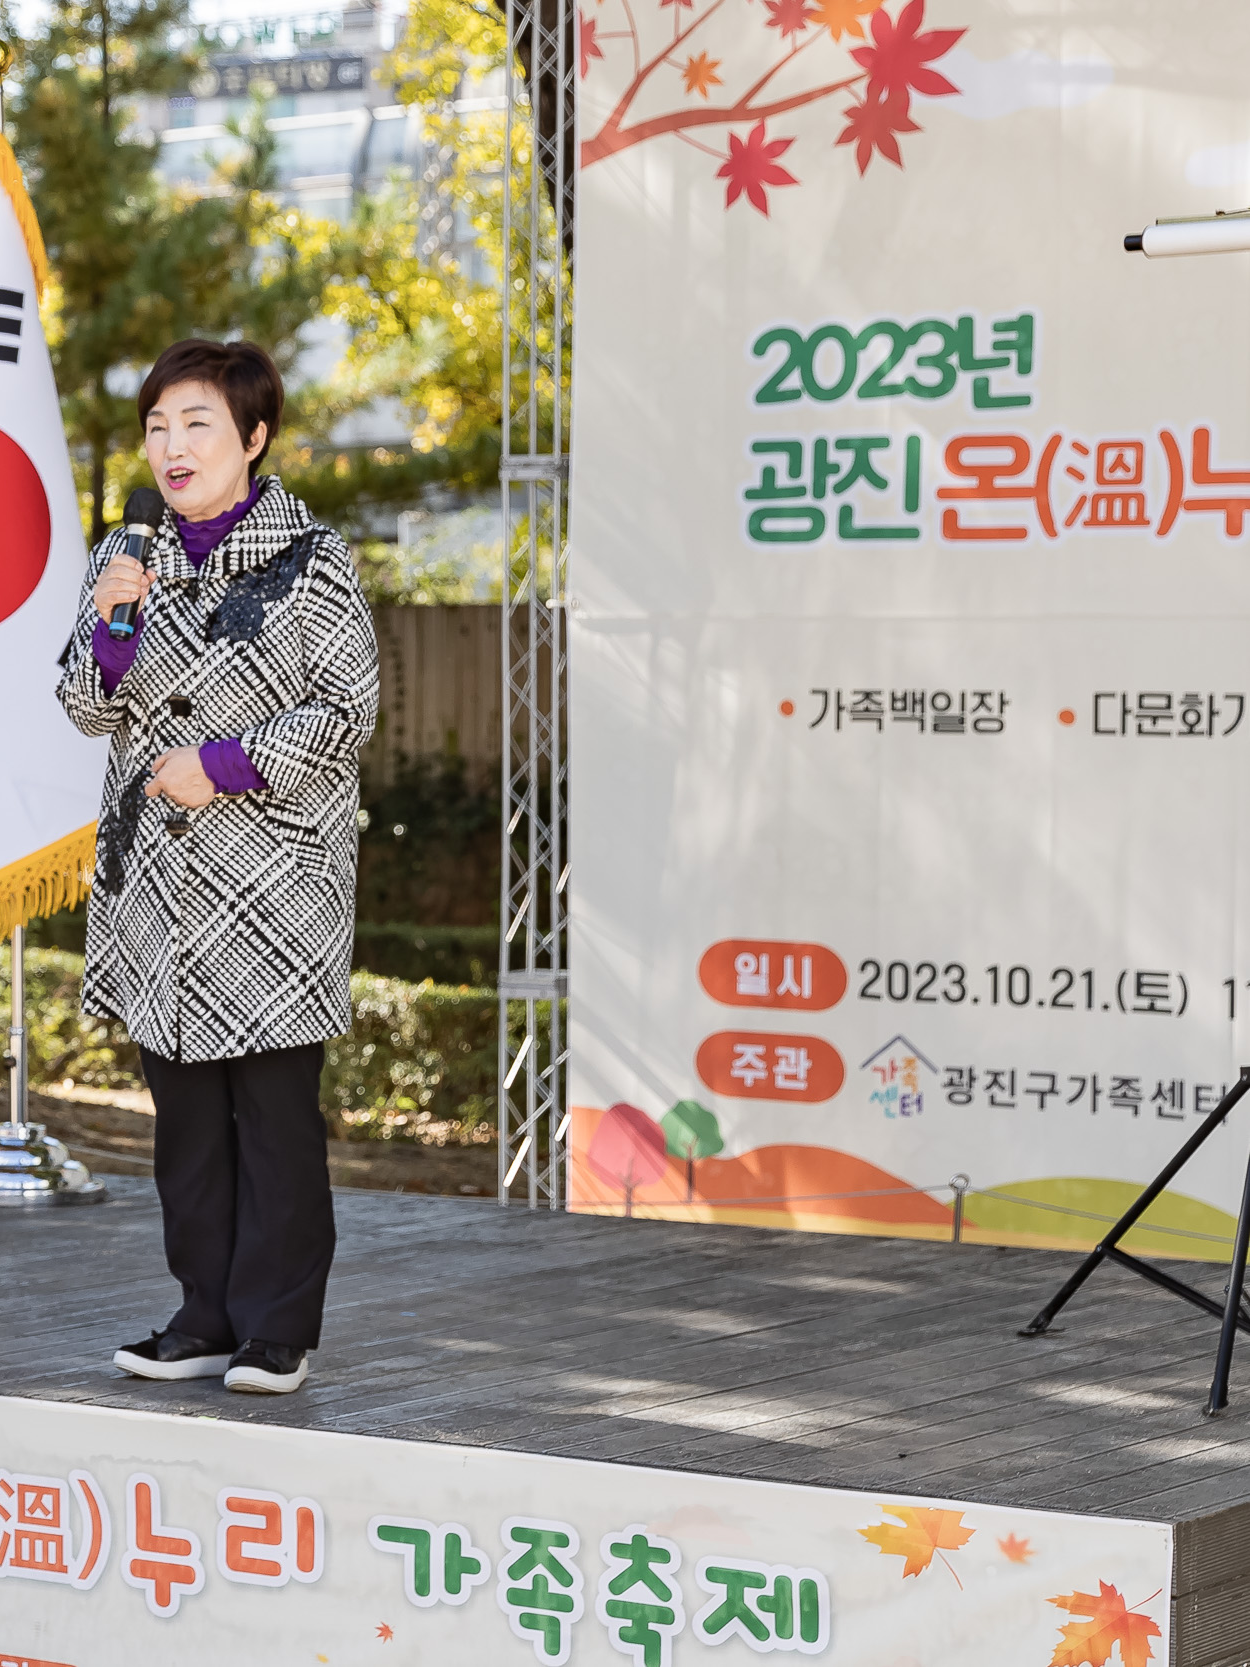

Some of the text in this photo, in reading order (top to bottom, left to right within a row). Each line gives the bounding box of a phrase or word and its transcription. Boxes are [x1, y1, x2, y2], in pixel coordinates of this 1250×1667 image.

[751, 314, 1035, 410] 2023년
[744, 434, 922, 542] 광진
[809, 688, 1008, 735] 가족백일장
[735, 952, 813, 999] 일시
[858, 958, 1189, 1017] 2023.10.21.(토)
[730, 1043, 1230, 1125] 주관 광진구가족센터
[376, 1525, 820, 1667] 가족축제
